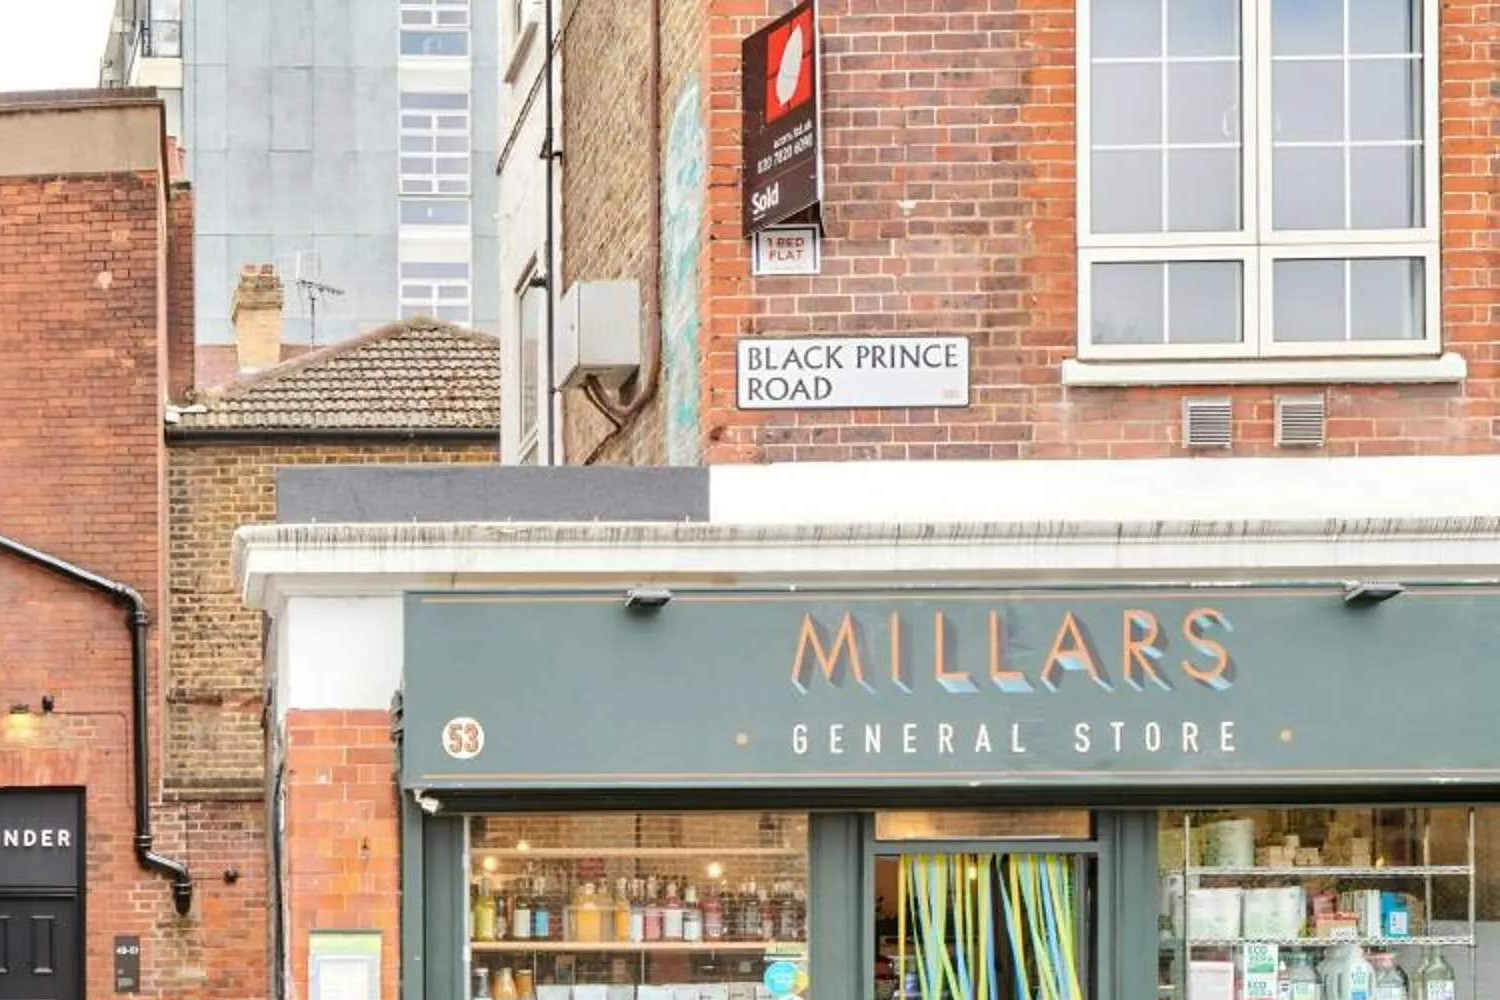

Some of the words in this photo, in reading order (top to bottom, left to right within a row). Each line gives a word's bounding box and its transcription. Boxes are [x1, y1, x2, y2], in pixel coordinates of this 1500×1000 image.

[752, 182, 779, 215] Sold
[768, 250, 805, 261] FLAT
[773, 237, 804, 248] BED
[748, 345, 844, 370] BLACK
[856, 343, 959, 369] PRINCE
[747, 376, 833, 401] ROAD
[791, 607, 1237, 694] MILLARS
[449, 723, 479, 753] 53
[793, 722, 1026, 753] GENERAL
[1074, 721, 1236, 752] STORE
